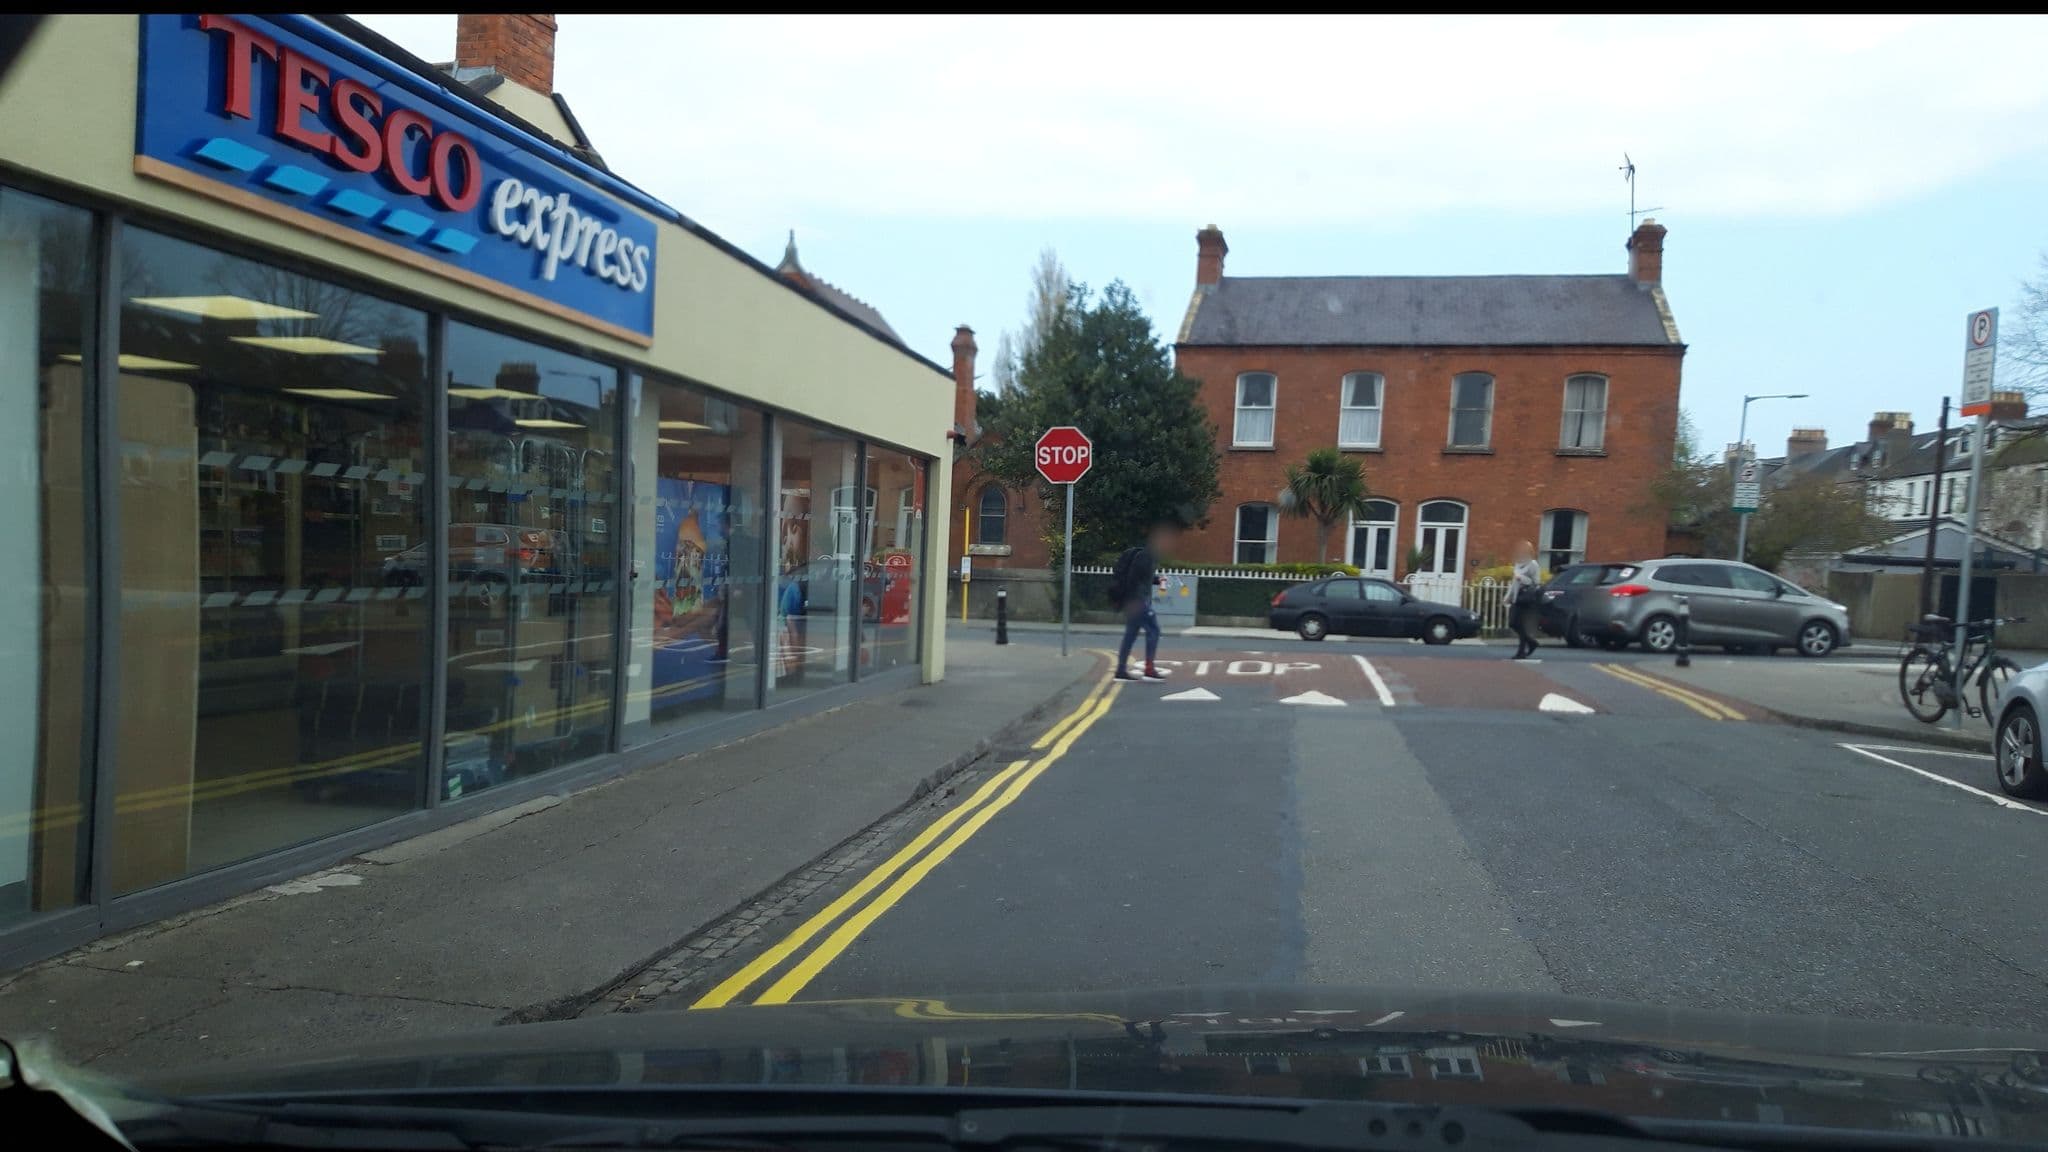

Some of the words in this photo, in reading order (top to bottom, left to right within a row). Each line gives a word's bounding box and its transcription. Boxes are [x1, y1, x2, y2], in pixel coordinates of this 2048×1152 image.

[199, 14, 482, 213] TESCO
[489, 178, 650, 293] express
[1038, 445, 1089, 465] STOP
[1128, 660, 1322, 676] STOP
